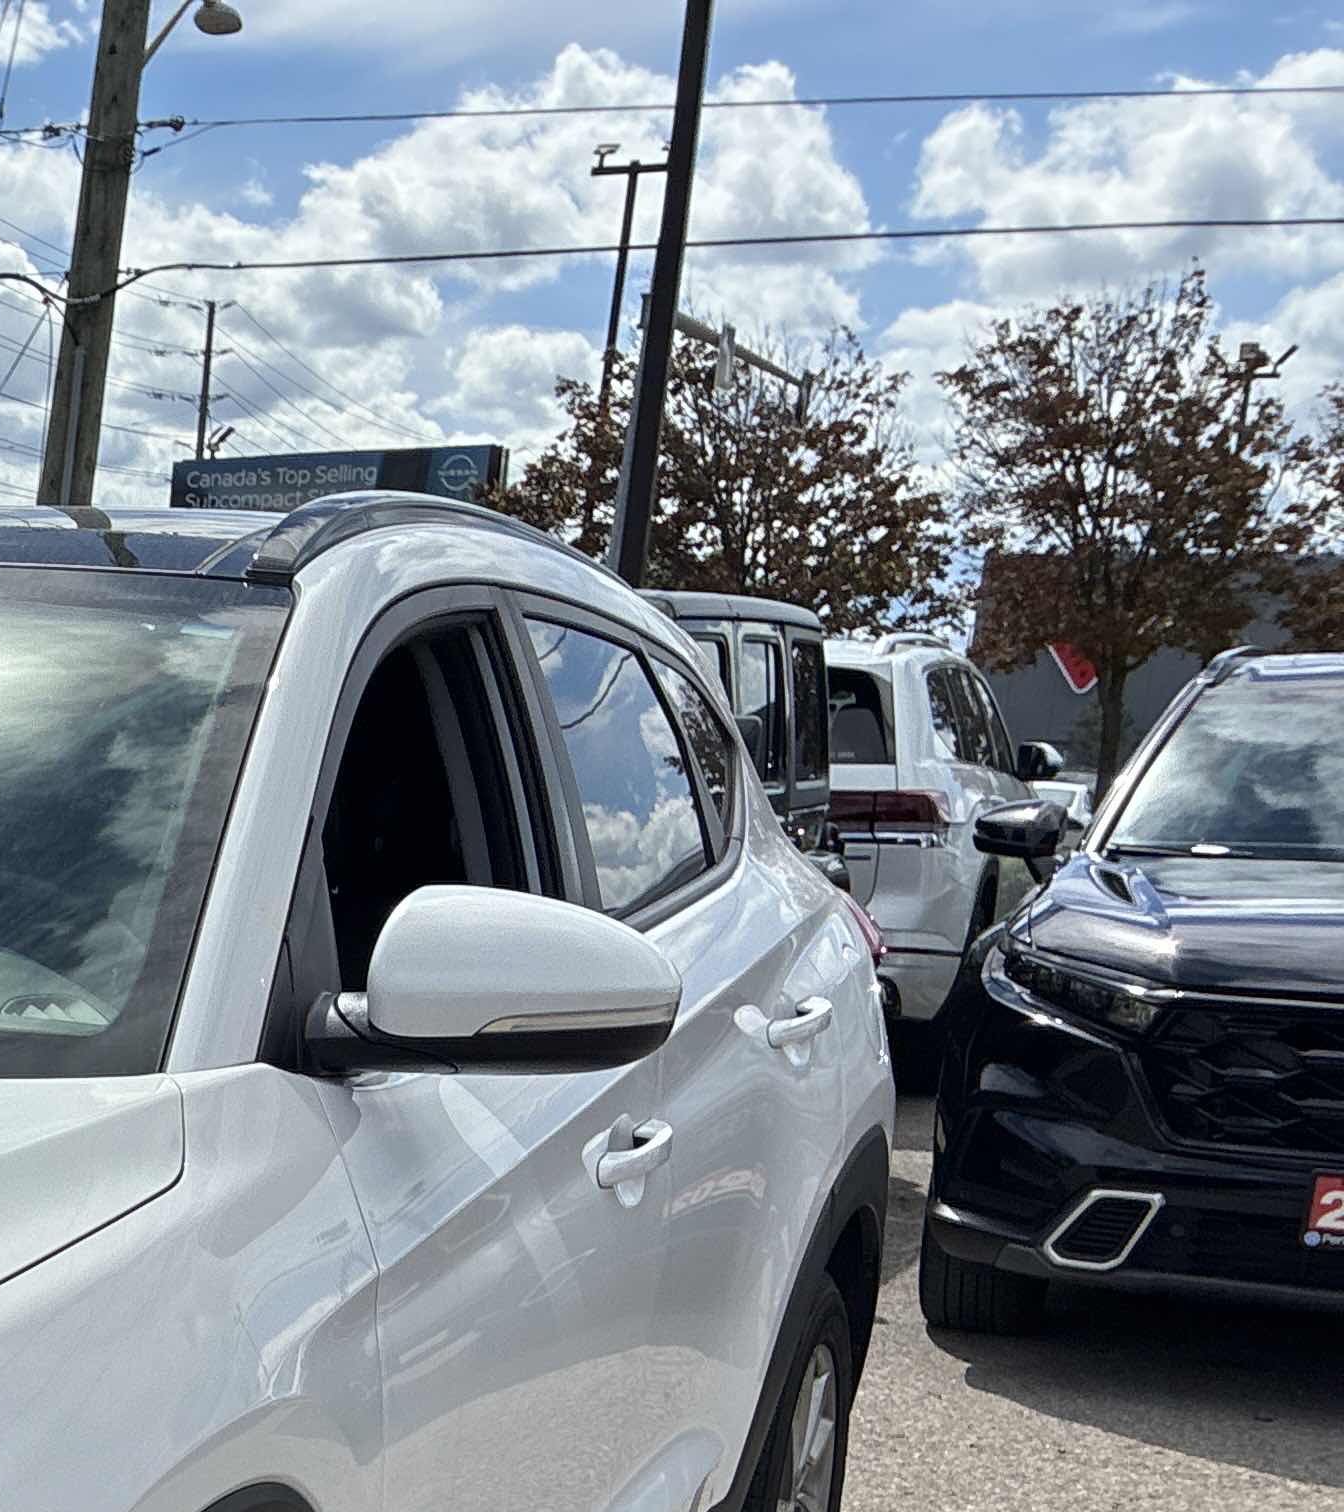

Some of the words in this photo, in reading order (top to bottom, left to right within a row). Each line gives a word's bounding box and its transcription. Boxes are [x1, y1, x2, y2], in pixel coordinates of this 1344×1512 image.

[186, 468, 272, 489] Canada's
[276, 466, 311, 487] Top
[315, 464, 378, 484] Selling
[185, 490, 302, 510] Subcompact
